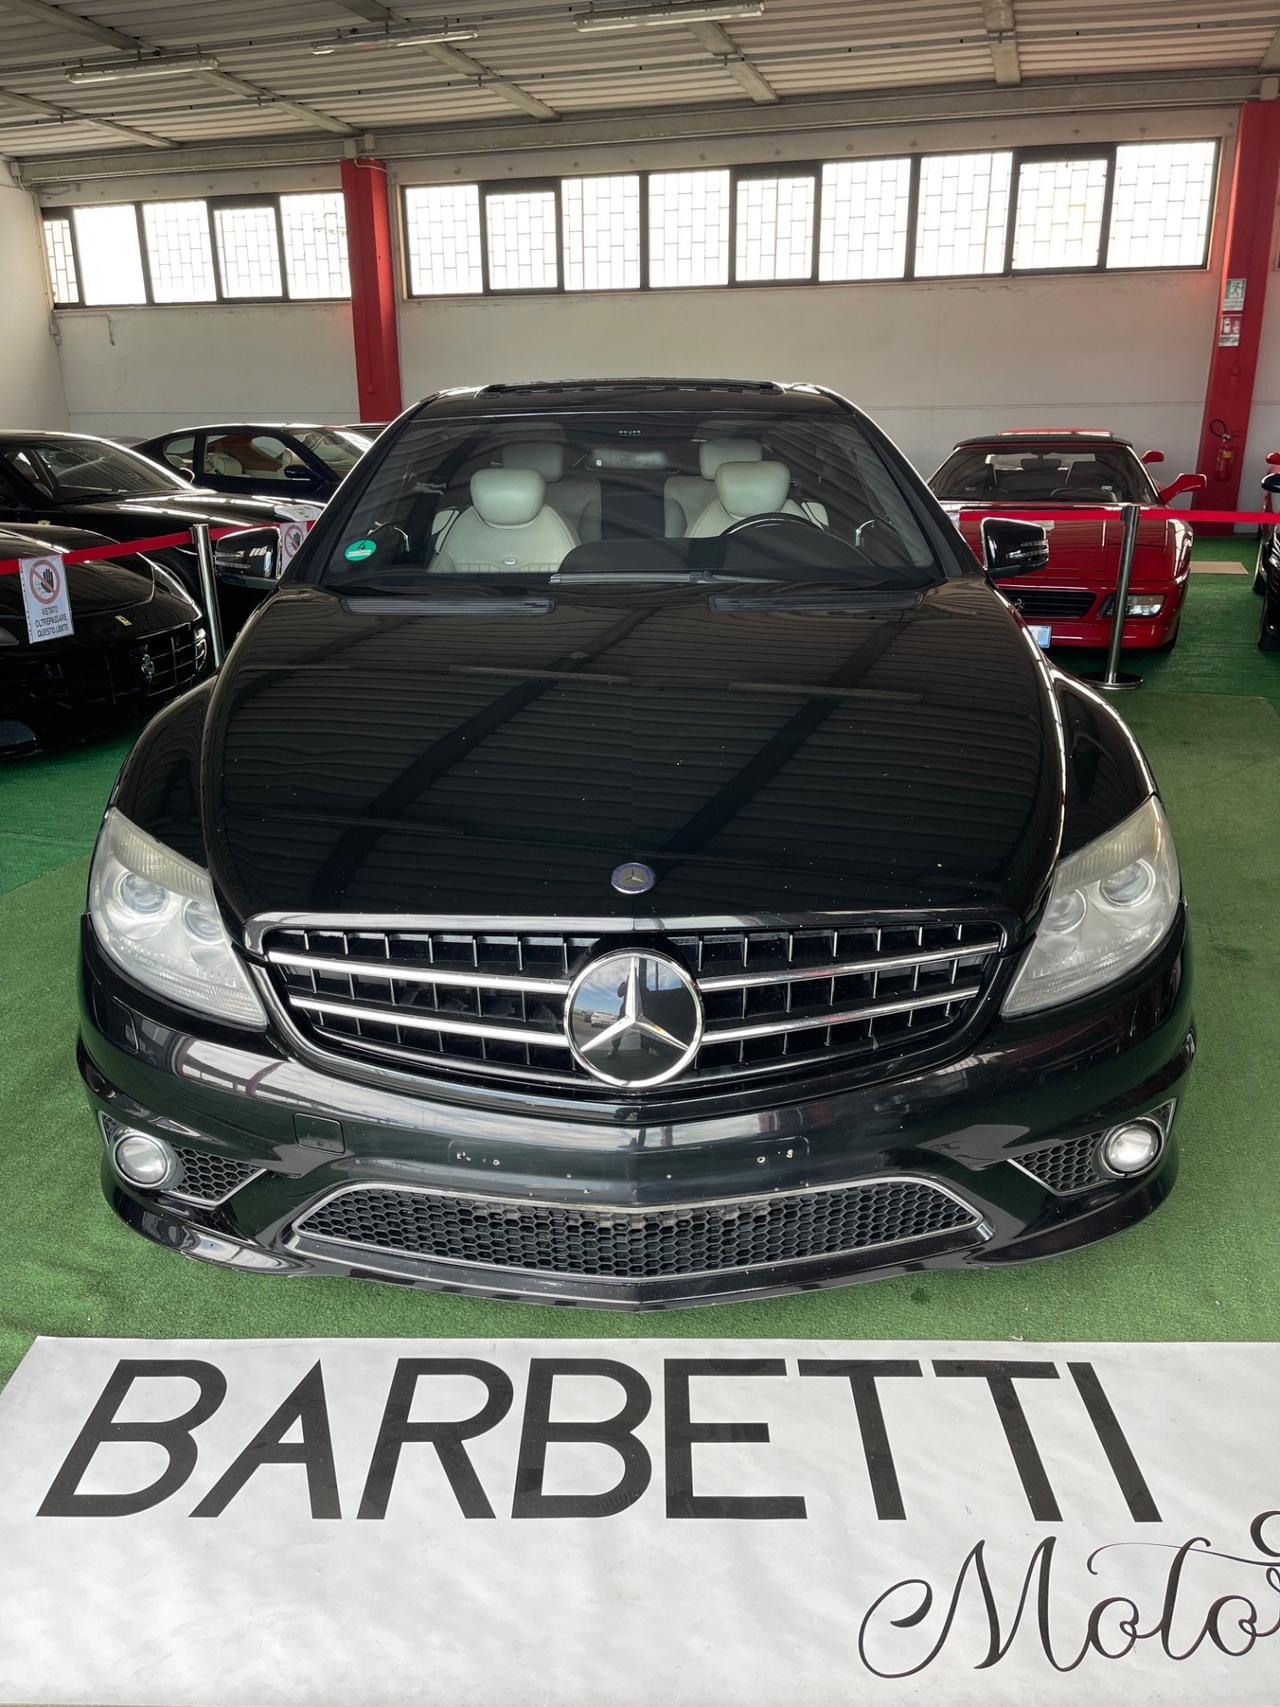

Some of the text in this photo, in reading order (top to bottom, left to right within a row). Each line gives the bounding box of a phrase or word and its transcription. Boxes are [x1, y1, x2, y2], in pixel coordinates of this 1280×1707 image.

[42, 605, 58, 615] VIETATO
[35, 613, 67, 627] OLTREPASSARE
[37, 627, 55, 637] QUESTO
[36, 1358, 1163, 1523] BARBETTI
